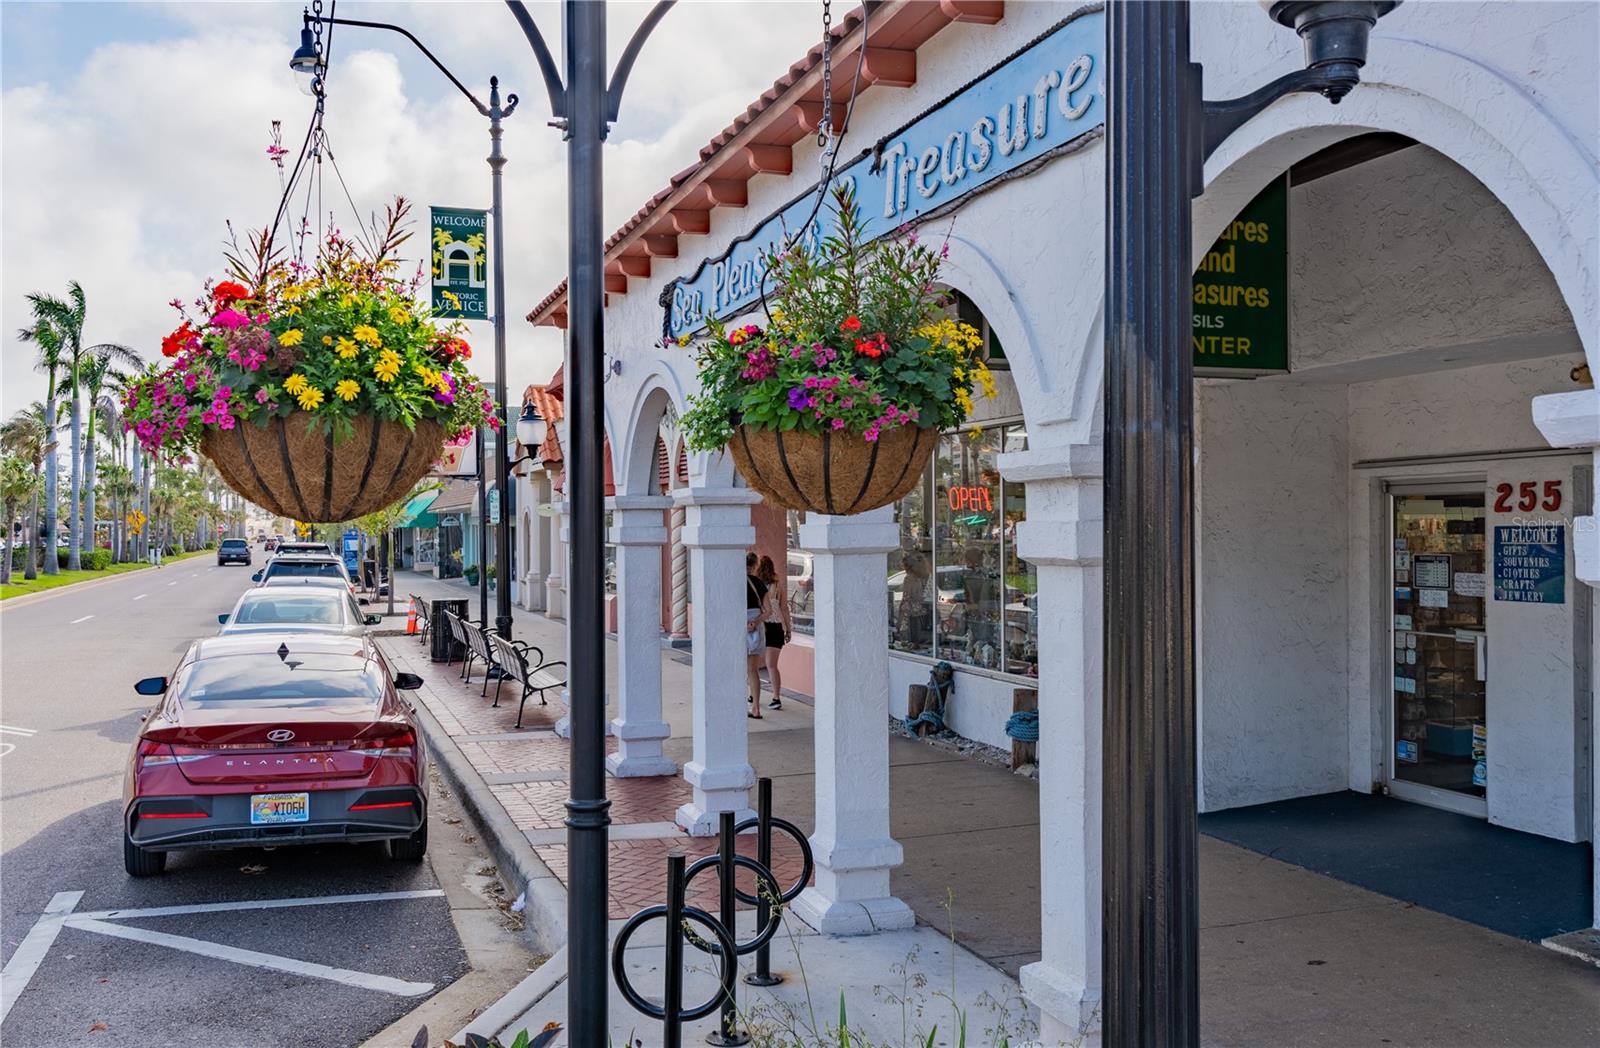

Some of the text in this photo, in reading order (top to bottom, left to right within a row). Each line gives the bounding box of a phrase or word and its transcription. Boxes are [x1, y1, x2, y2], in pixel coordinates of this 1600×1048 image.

[671, 287, 702, 332] Sea
[881, 54, 1105, 219] Treasure
[433, 215, 486, 228] WELCOME
[1220, 220, 1269, 244] ures
[1193, 283, 1270, 308] asures
[435, 299, 485, 312] VEICE
[1192, 314, 1225, 329] SILS
[1192, 336, 1252, 355] NTER
[949, 486, 992, 512] OPEN
[1493, 480, 1562, 513] 255
[1500, 528, 1558, 543] WELCOME
[1503, 546, 1528, 556] GIFTS
[1503, 557, 1550, 568] SOUVENIRS
[1503, 568, 1541, 579] CLOTHES
[1502, 580, 1536, 591] CRAFTS
[1503, 591, 1544, 602] JEWLERY
[226, 757, 334, 767] ELANTRA
